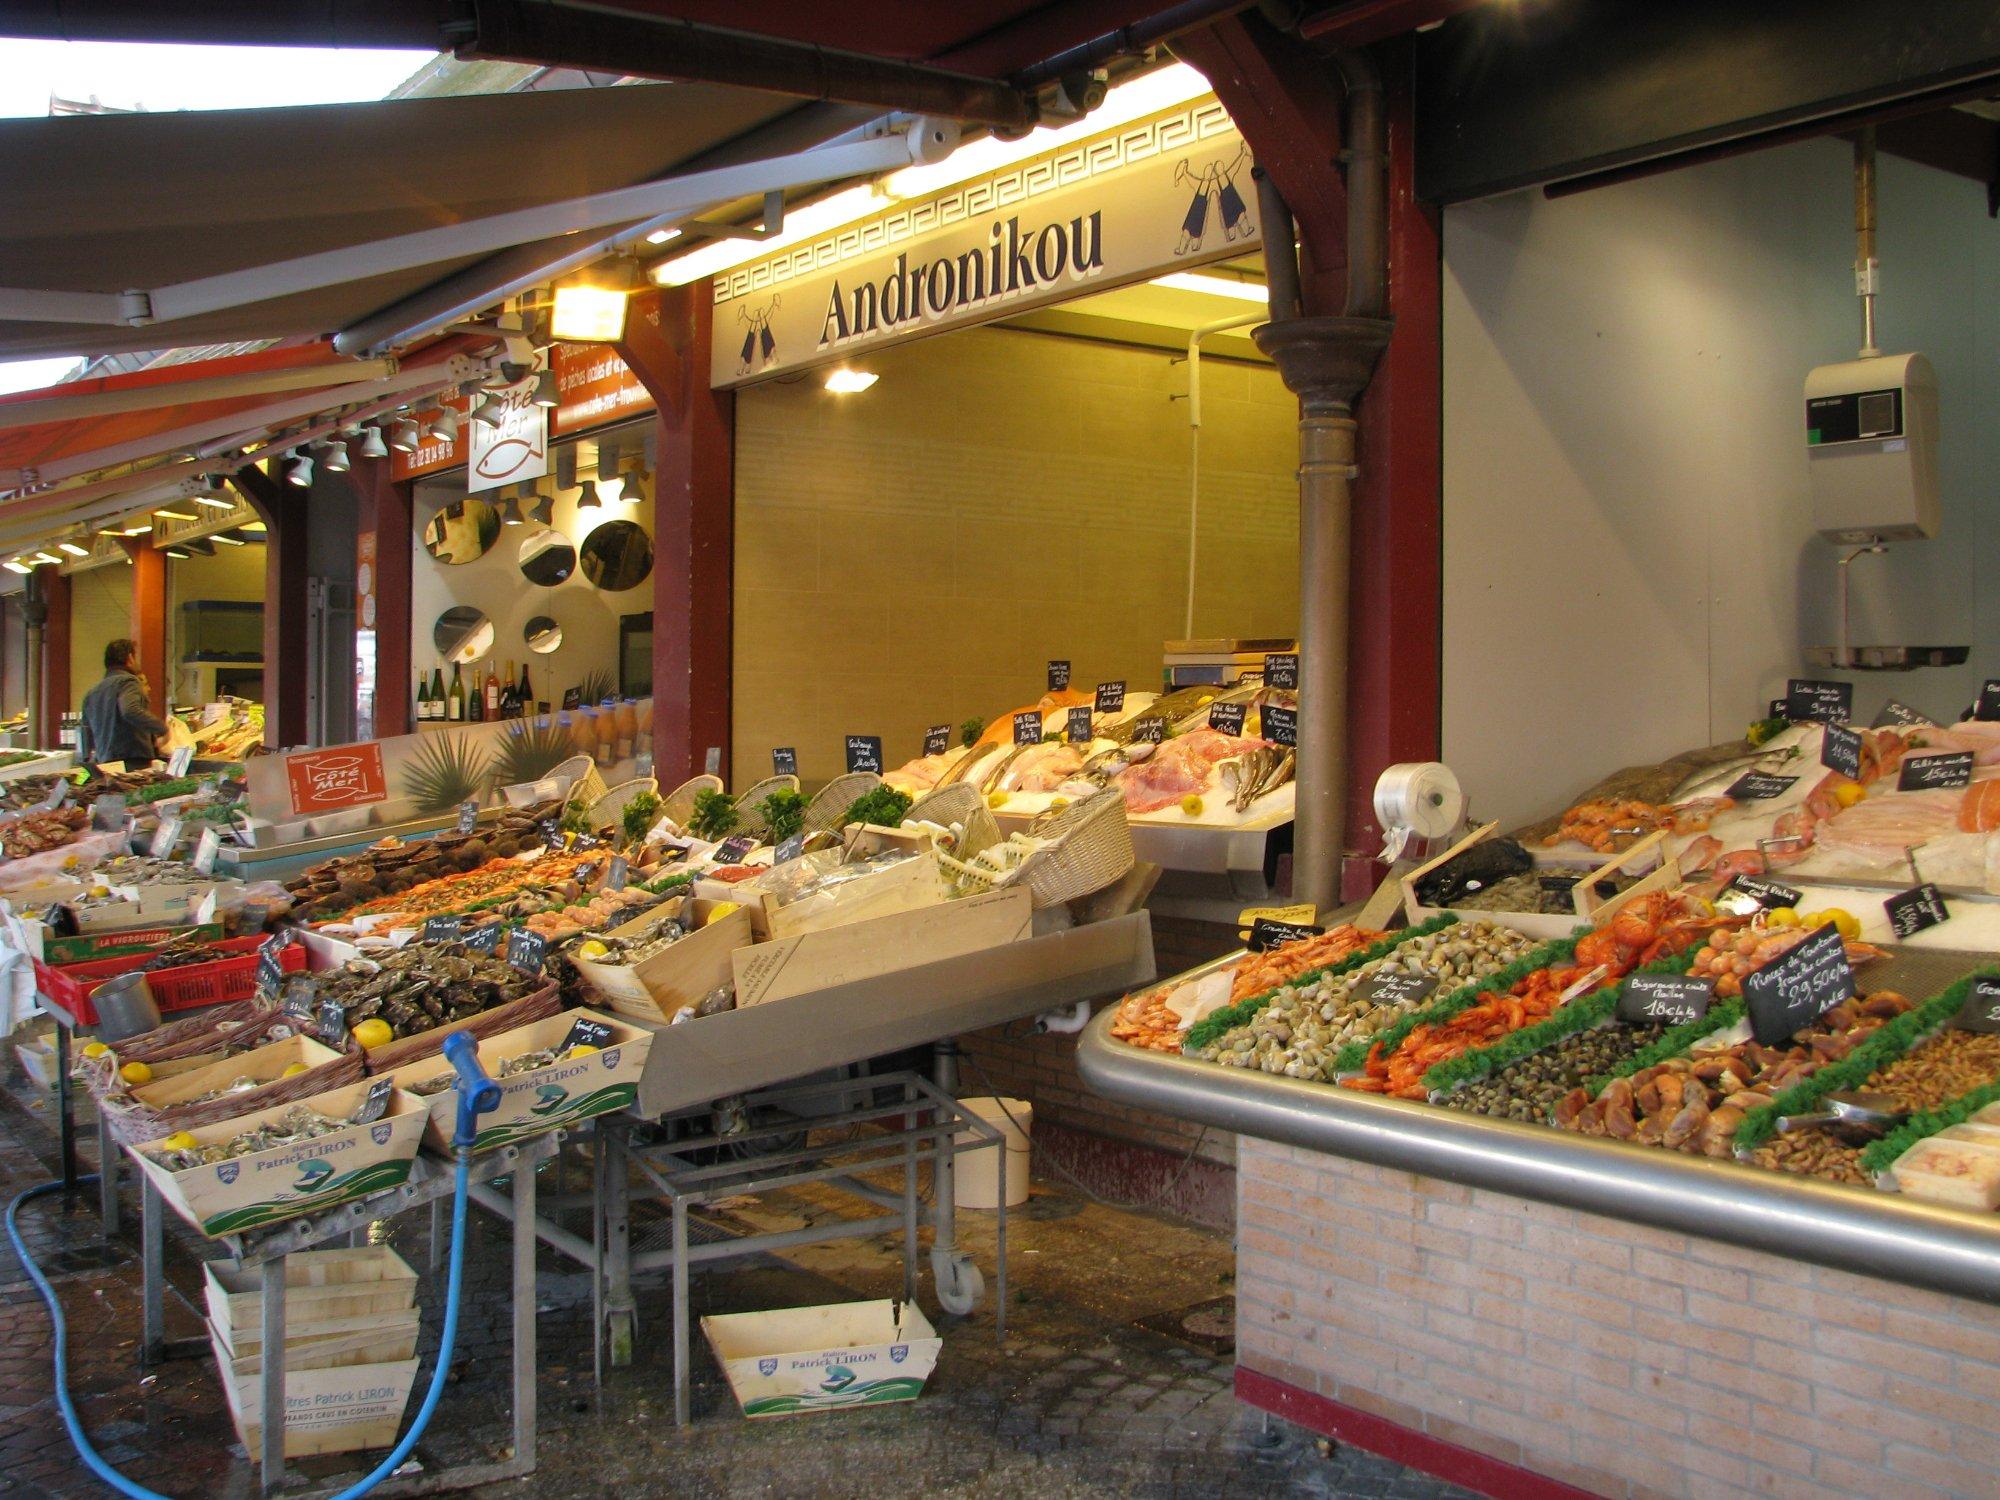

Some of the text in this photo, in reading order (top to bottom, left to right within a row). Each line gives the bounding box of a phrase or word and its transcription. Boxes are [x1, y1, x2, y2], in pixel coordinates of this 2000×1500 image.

[818, 209, 1104, 348] Andronikou
[498, 381, 535, 416] ôté
[486, 415, 528, 444] Mer
[312, 766, 360, 782] Côté
[315, 777, 358, 791] Mer
[1631, 978, 1682, 991] Bigorneaux
[500, 1063, 590, 1095] Patrick LIRON
[256, 1138, 357, 1172] Patrick LIRON
[791, 1352, 877, 1369] Patrick LIRON
[315, 1391, 354, 1405] Patrick
[358, 1386, 396, 1401] LIRON
[284, 1411, 313, 1421] RANDS
[337, 1409, 348, 1417] EN
